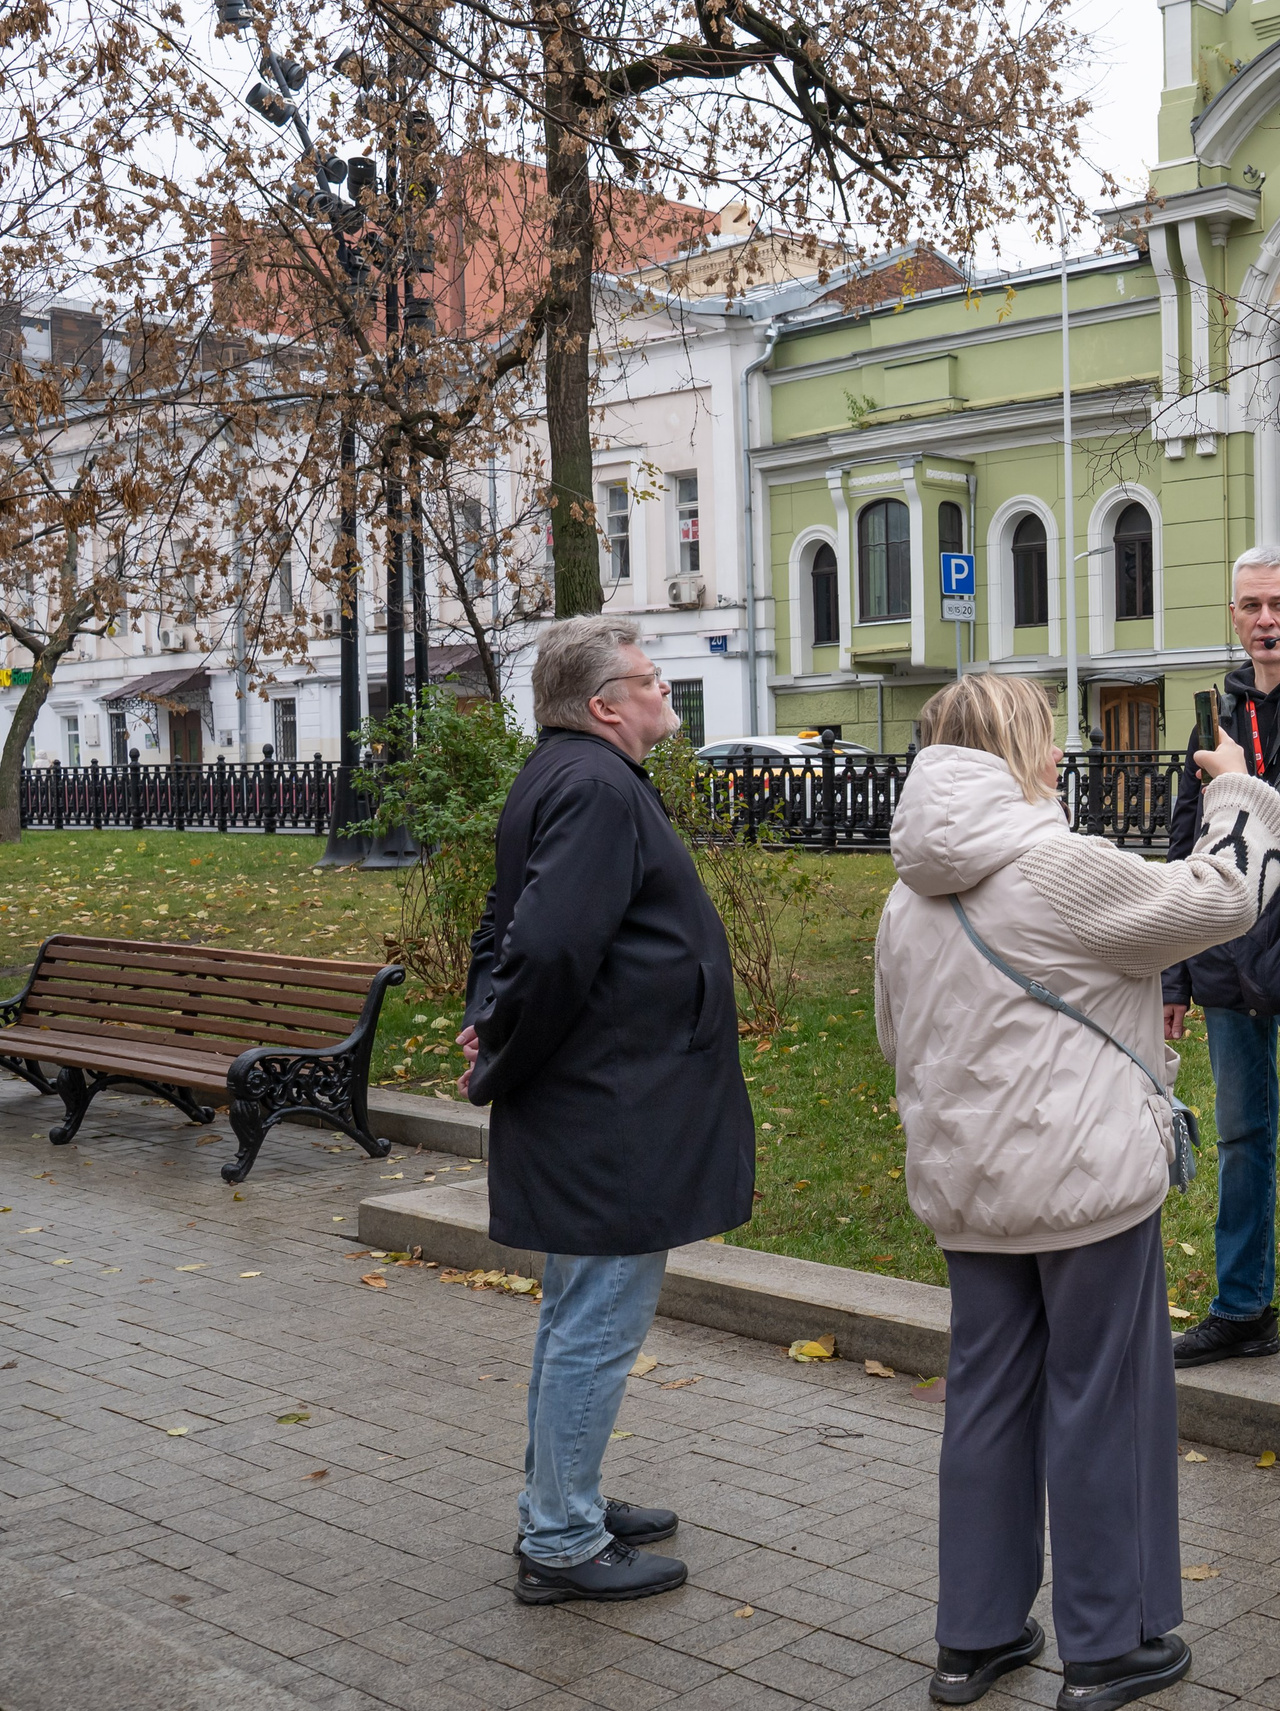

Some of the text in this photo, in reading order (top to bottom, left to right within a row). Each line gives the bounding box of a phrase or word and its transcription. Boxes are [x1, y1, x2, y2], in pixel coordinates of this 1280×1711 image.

[950, 558, 969, 590] P
[954, 606, 961, 614] 15
[962, 606, 972, 615] 20
